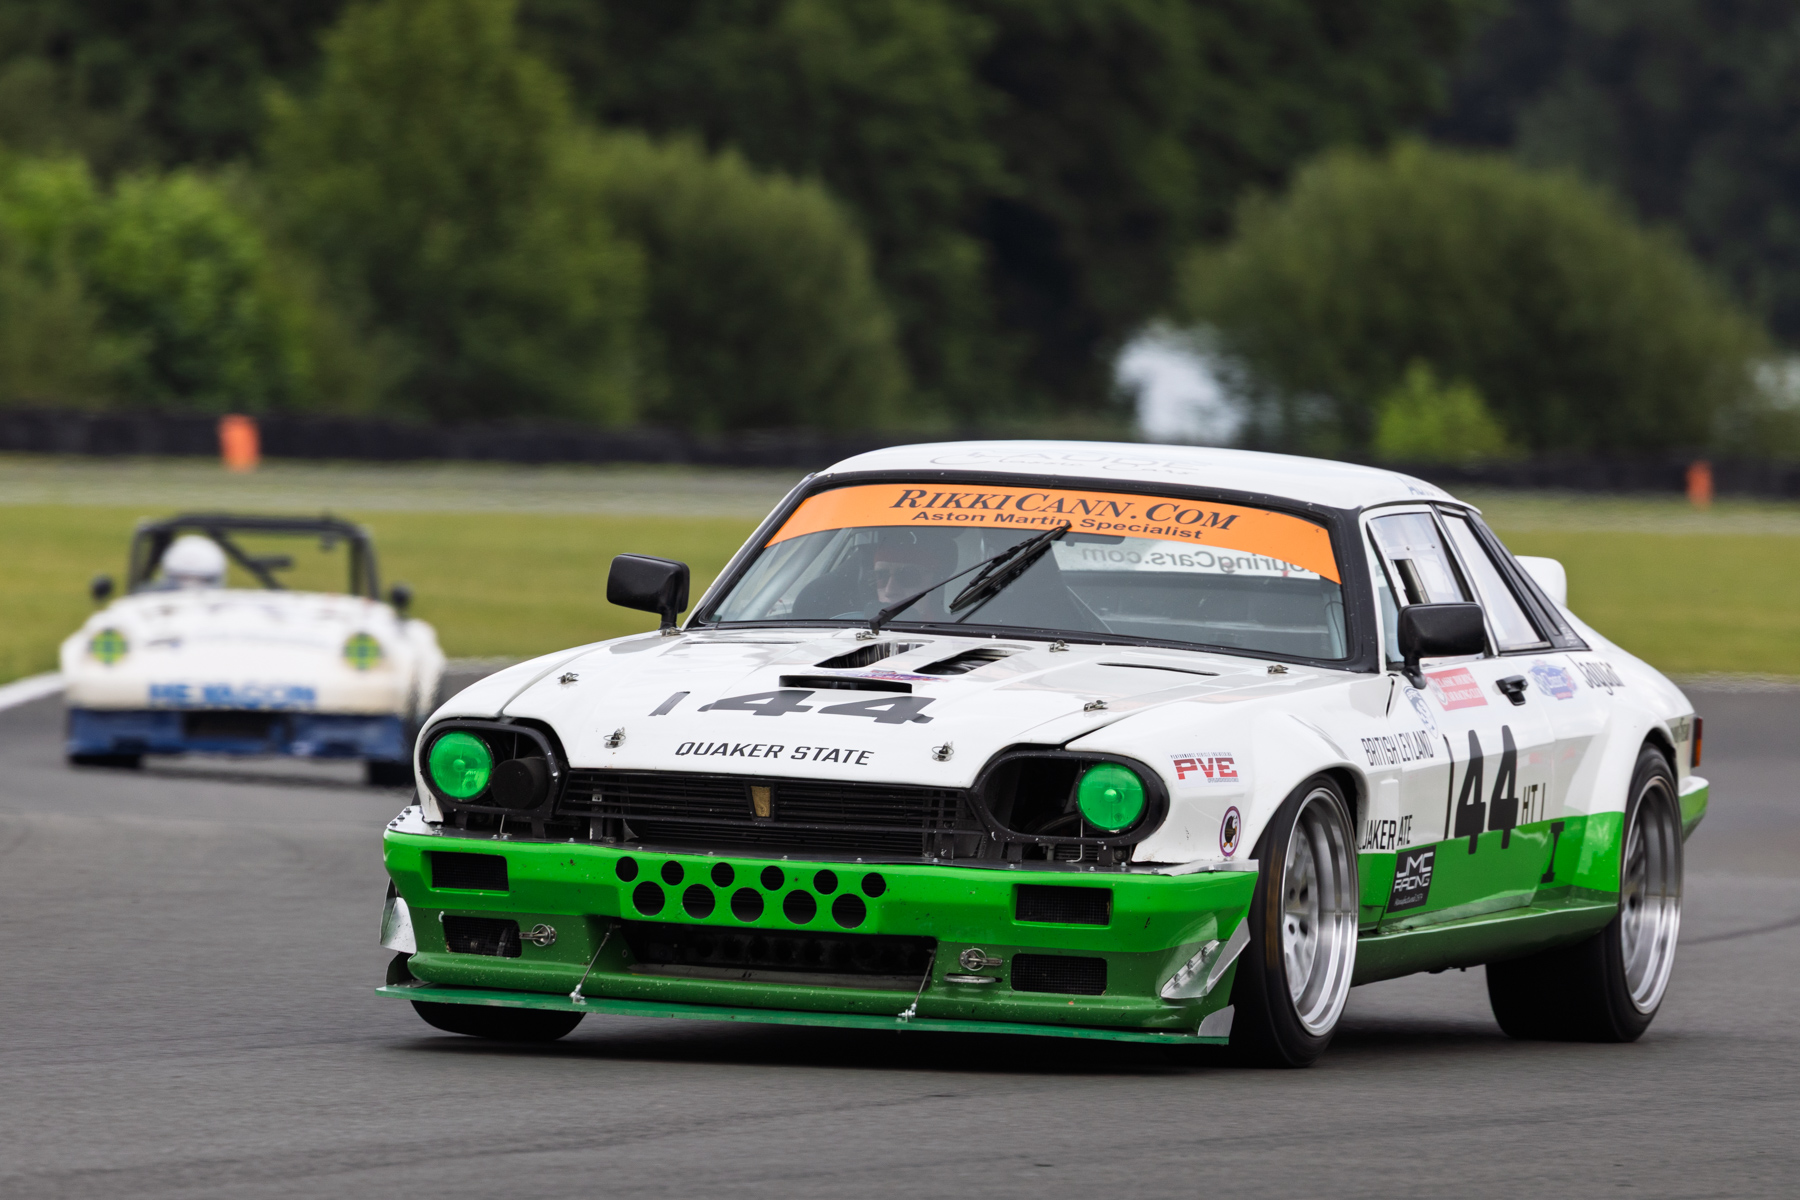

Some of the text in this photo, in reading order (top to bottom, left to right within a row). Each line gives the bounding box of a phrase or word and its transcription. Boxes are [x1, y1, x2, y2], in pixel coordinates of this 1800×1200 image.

[912, 510, 1203, 540] Aston Martin Specialist
[648, 690, 937, 725] 144
[675, 741, 875, 766] QUAKER STATE
[1361, 730, 1434, 766] BRITISH LEYLAND
[1173, 757, 1238, 780] PVE
[1442, 724, 1519, 855] 144
[1396, 851, 1434, 879] JMC
